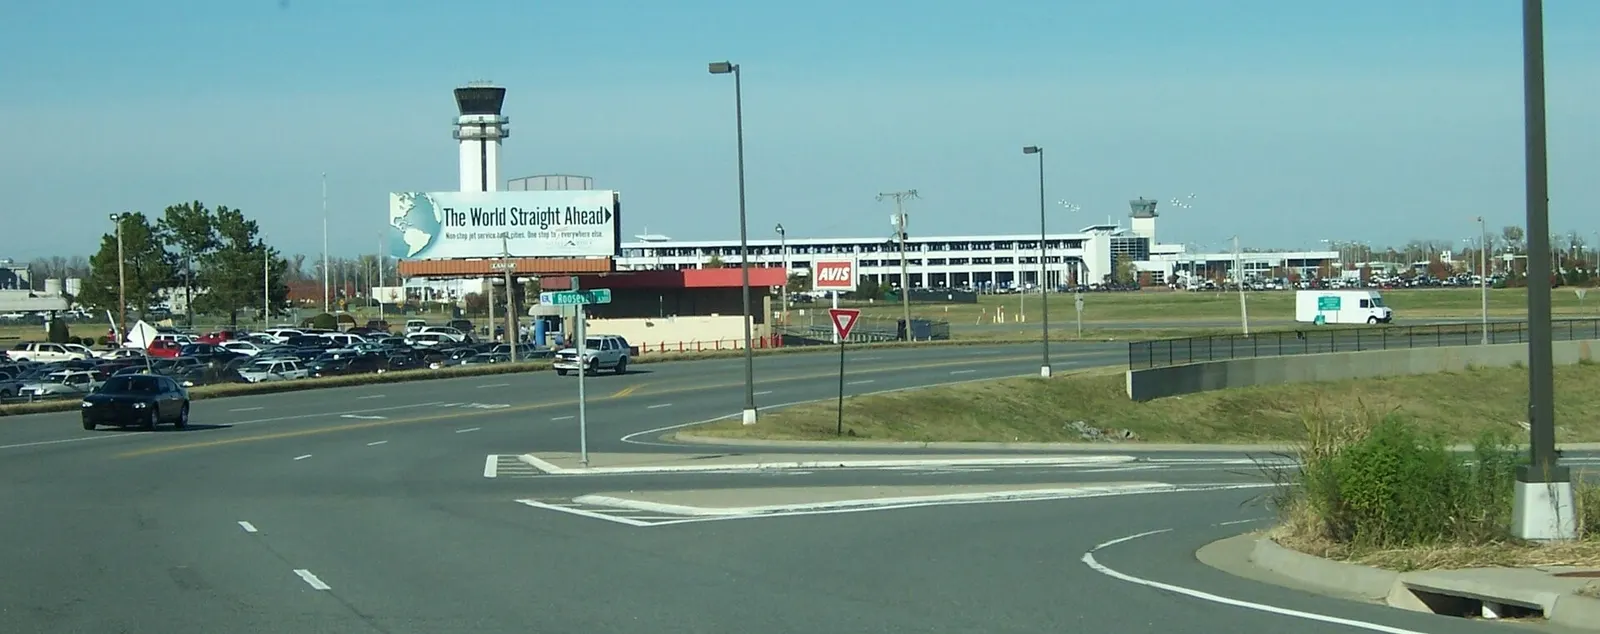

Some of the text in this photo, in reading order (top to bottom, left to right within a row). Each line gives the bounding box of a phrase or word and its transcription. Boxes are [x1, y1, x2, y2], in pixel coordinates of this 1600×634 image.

[443, 206, 604, 230] The World Straight Ahead
[469, 232, 477, 241] jet
[478, 232, 496, 240] service
[527, 231, 537, 239] One
[538, 231, 550, 240] stop
[551, 231, 557, 239] to
[561, 231, 590, 240] everywhere
[818, 267, 850, 281] AVIS
